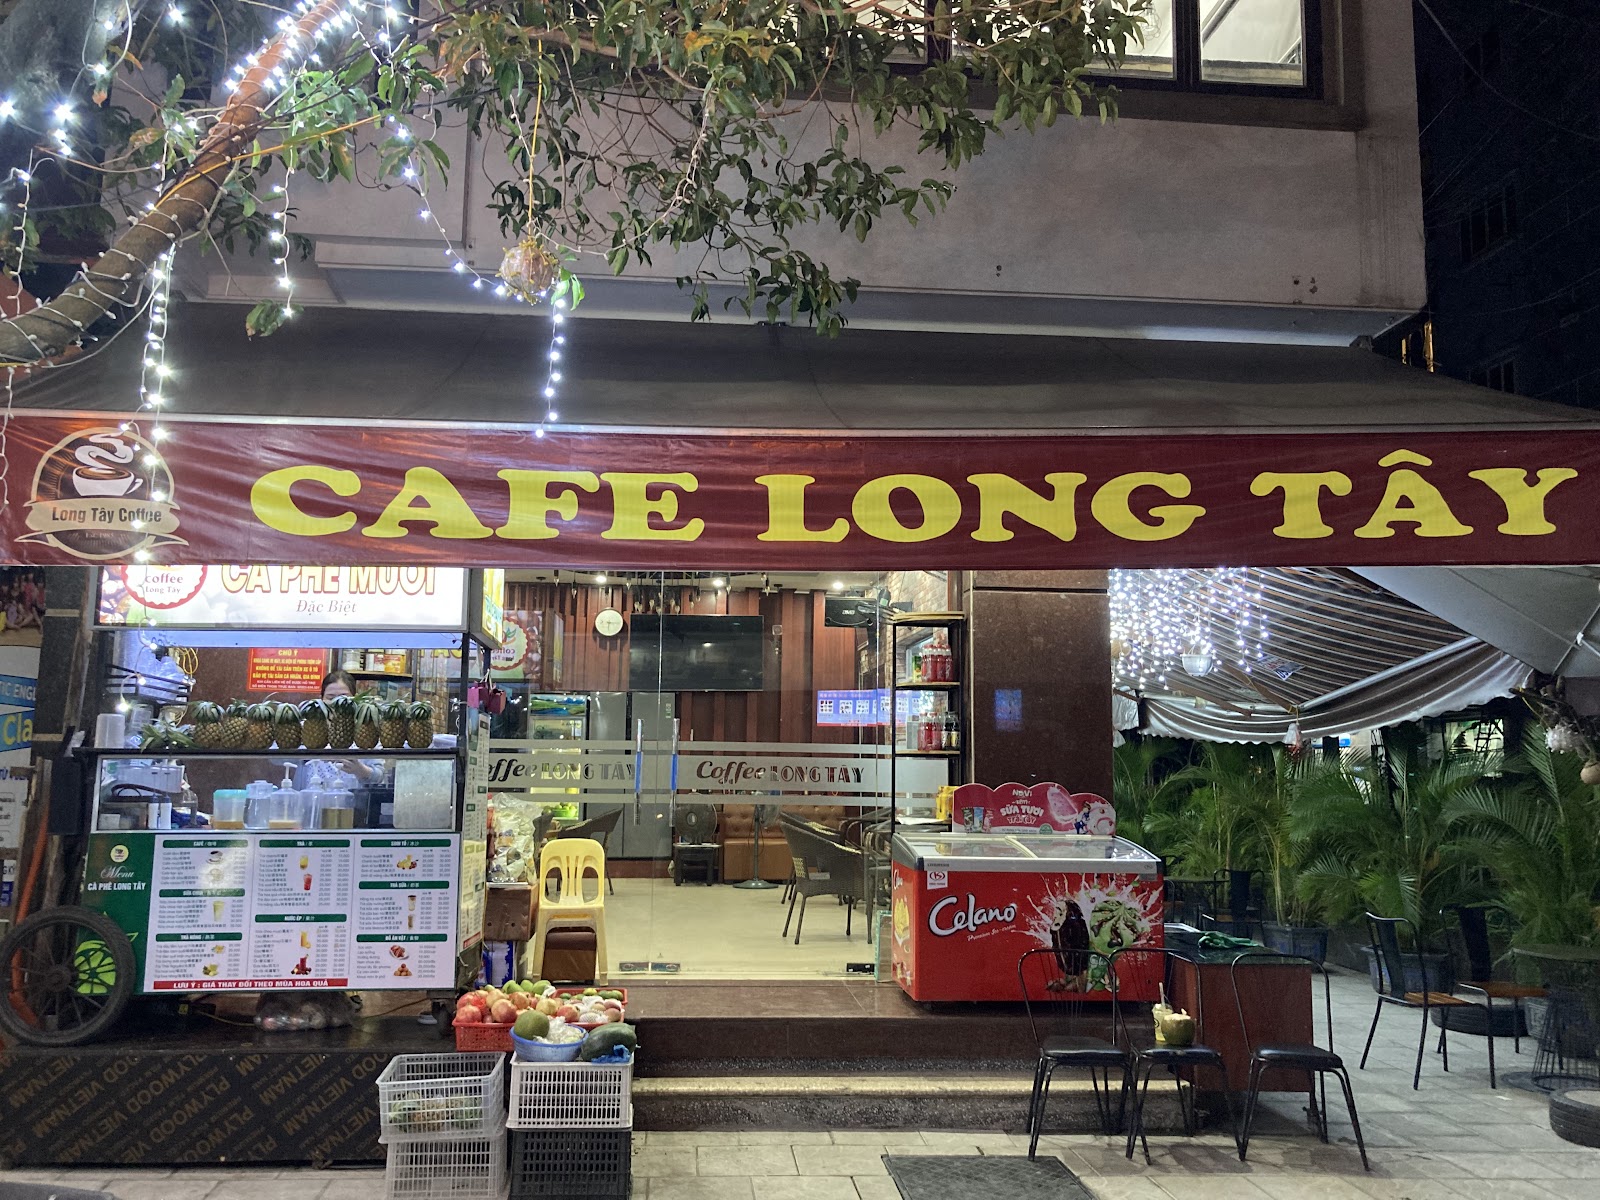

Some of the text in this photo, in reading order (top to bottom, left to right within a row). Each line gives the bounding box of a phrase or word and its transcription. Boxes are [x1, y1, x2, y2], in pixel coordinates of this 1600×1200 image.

[250, 448, 1578, 543] CAFE LONG TÂY
[52, 507, 162, 524] Long Tây Coffee
[145, 573, 184, 584] coffee
[146, 586, 164, 594] Long
[296, 599, 357, 616] Đặc Biệt
[488, 758, 538, 782] offee
[540, 762, 594, 780] LONG
[696, 760, 766, 785] Coffee
[770, 765, 821, 783] LONG
[100, 866, 134, 878] Menu
[87, 881, 146, 891] CÀ PHÊ LONG TÂY
[928, 892, 1017, 937] Celano
[202, 980, 216, 988] GIÁ
[146, 1075, 233, 1146] PLYWOOD
[280, 1074, 356, 1137] VIETNAM
